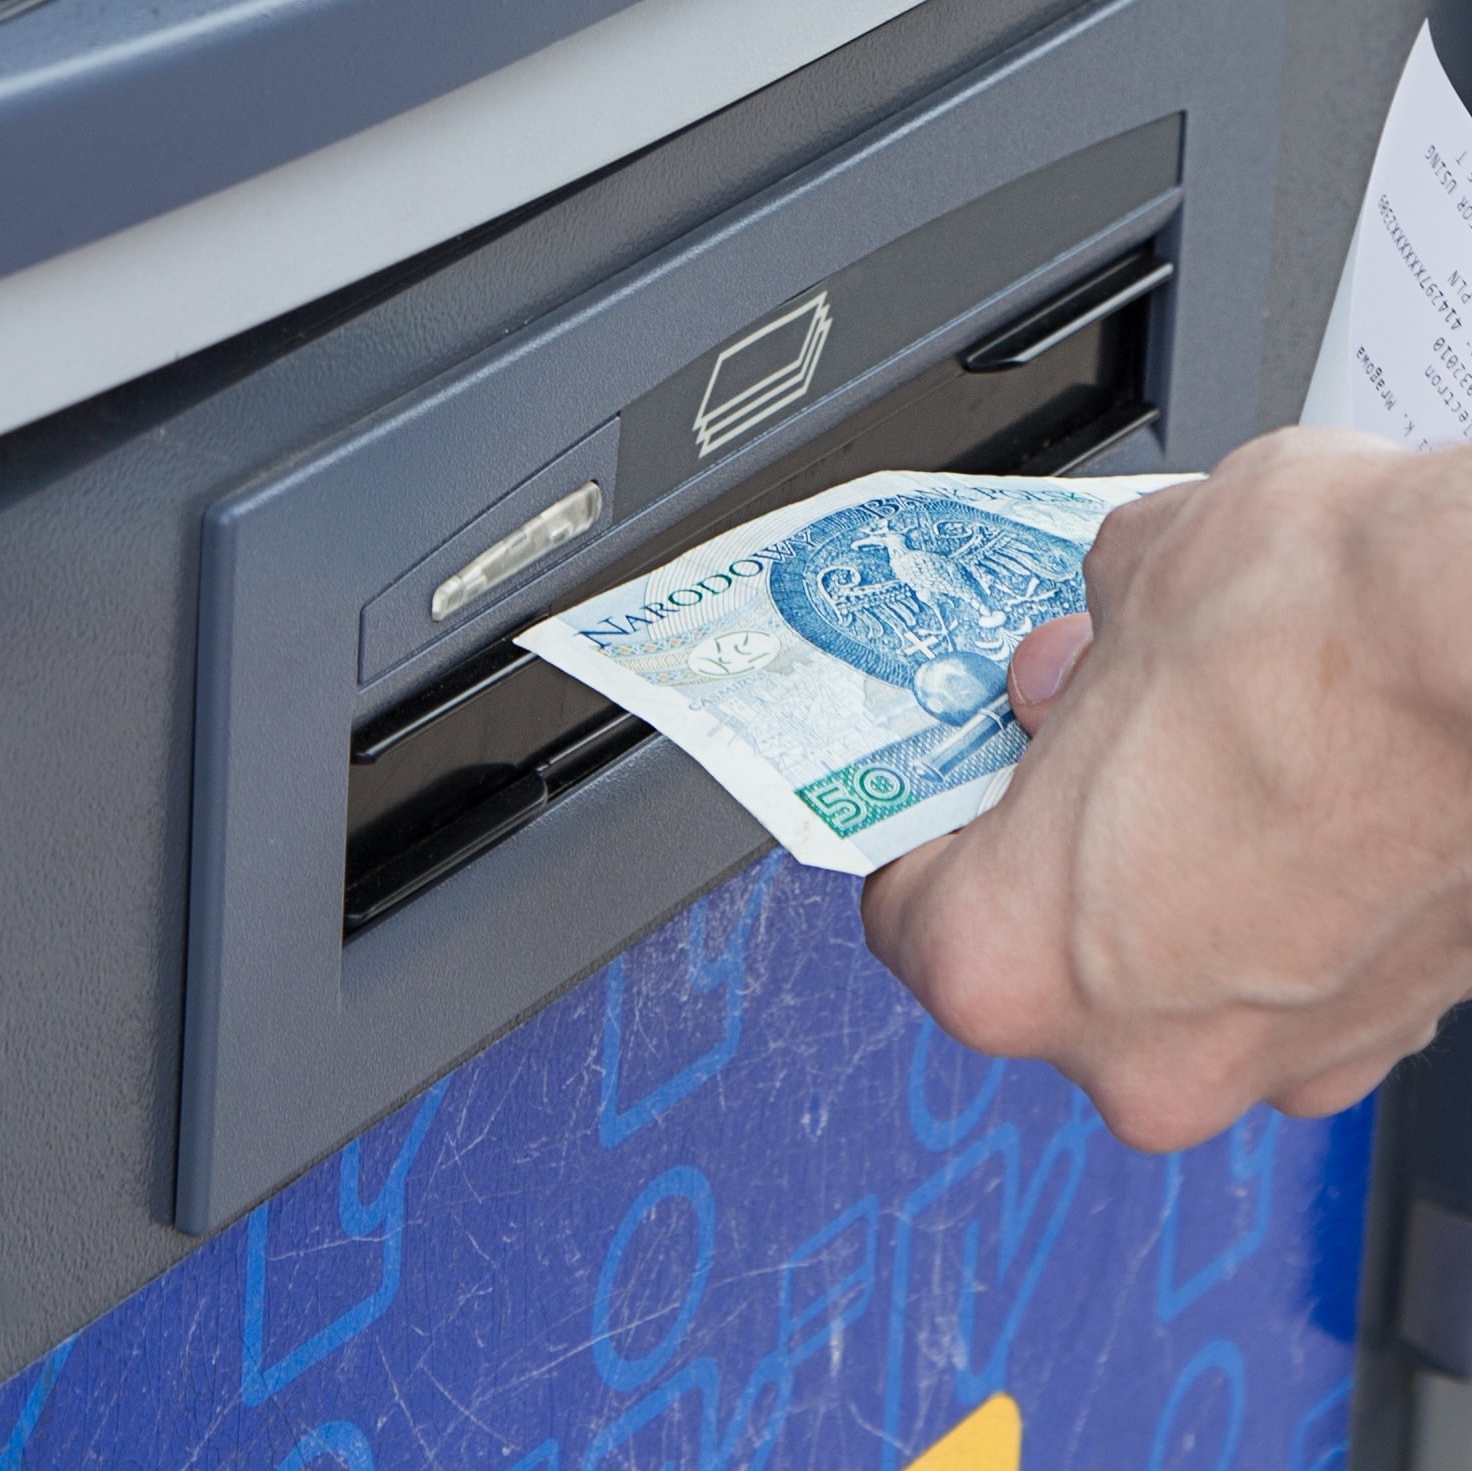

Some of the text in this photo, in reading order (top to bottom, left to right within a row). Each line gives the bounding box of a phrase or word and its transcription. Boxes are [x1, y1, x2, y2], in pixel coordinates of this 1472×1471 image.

[1424, 144, 1457, 193] USING
[577, 526, 820, 651] NARODOWY
[861, 487, 970, 521] BANK
[811, 762, 909, 831] 50
